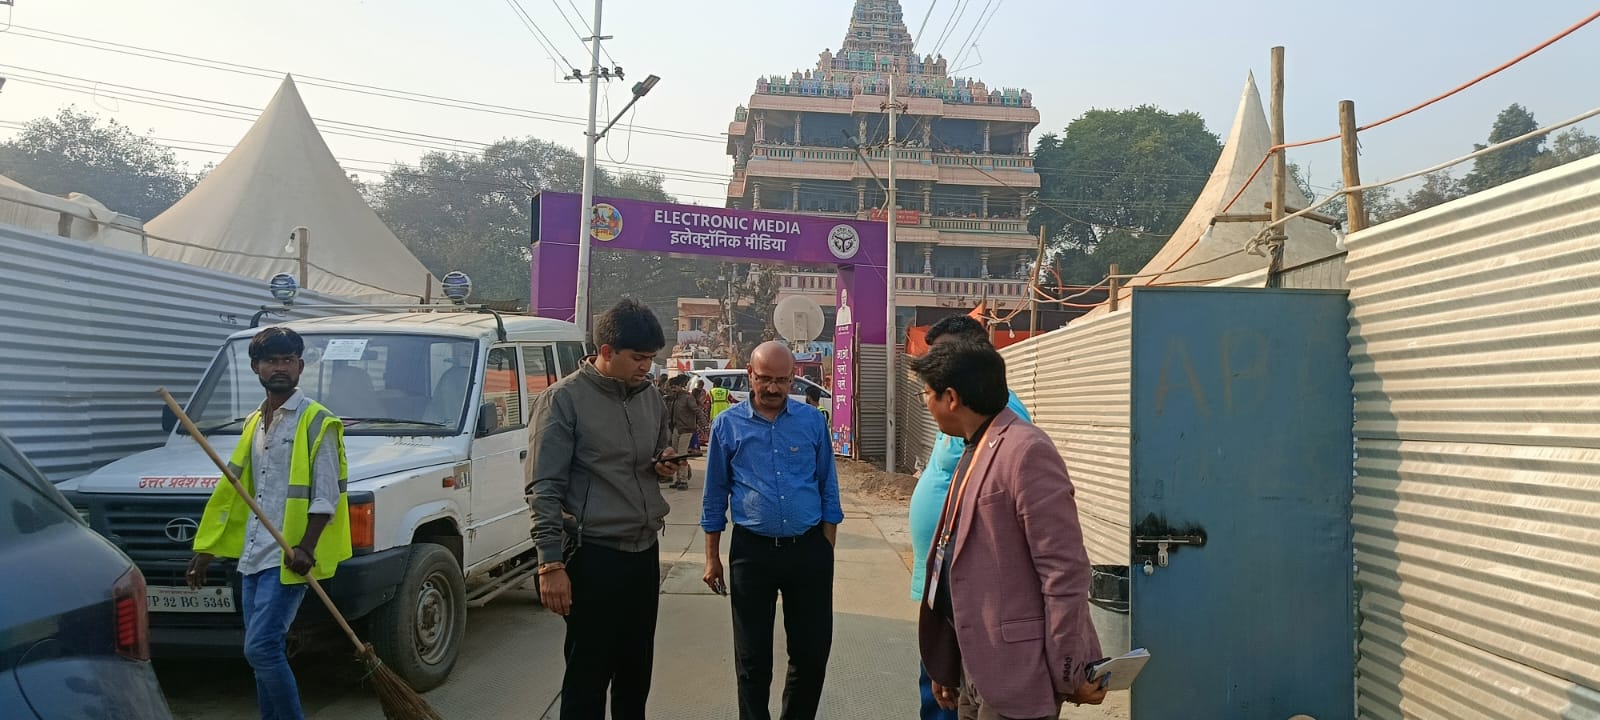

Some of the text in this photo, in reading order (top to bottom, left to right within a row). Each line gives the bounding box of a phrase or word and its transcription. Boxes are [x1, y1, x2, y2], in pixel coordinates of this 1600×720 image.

[654, 209, 801, 235] ELECTRONIC MEDIA
[670, 228, 787, 252] इलेक्ट्रॉनिक मीडिया
[139, 474, 222, 489] उत्तर प्रदेश सर
[163, 596, 177, 608] 32
[181, 596, 199, 608] BG
[203, 597, 231, 608] 5346
